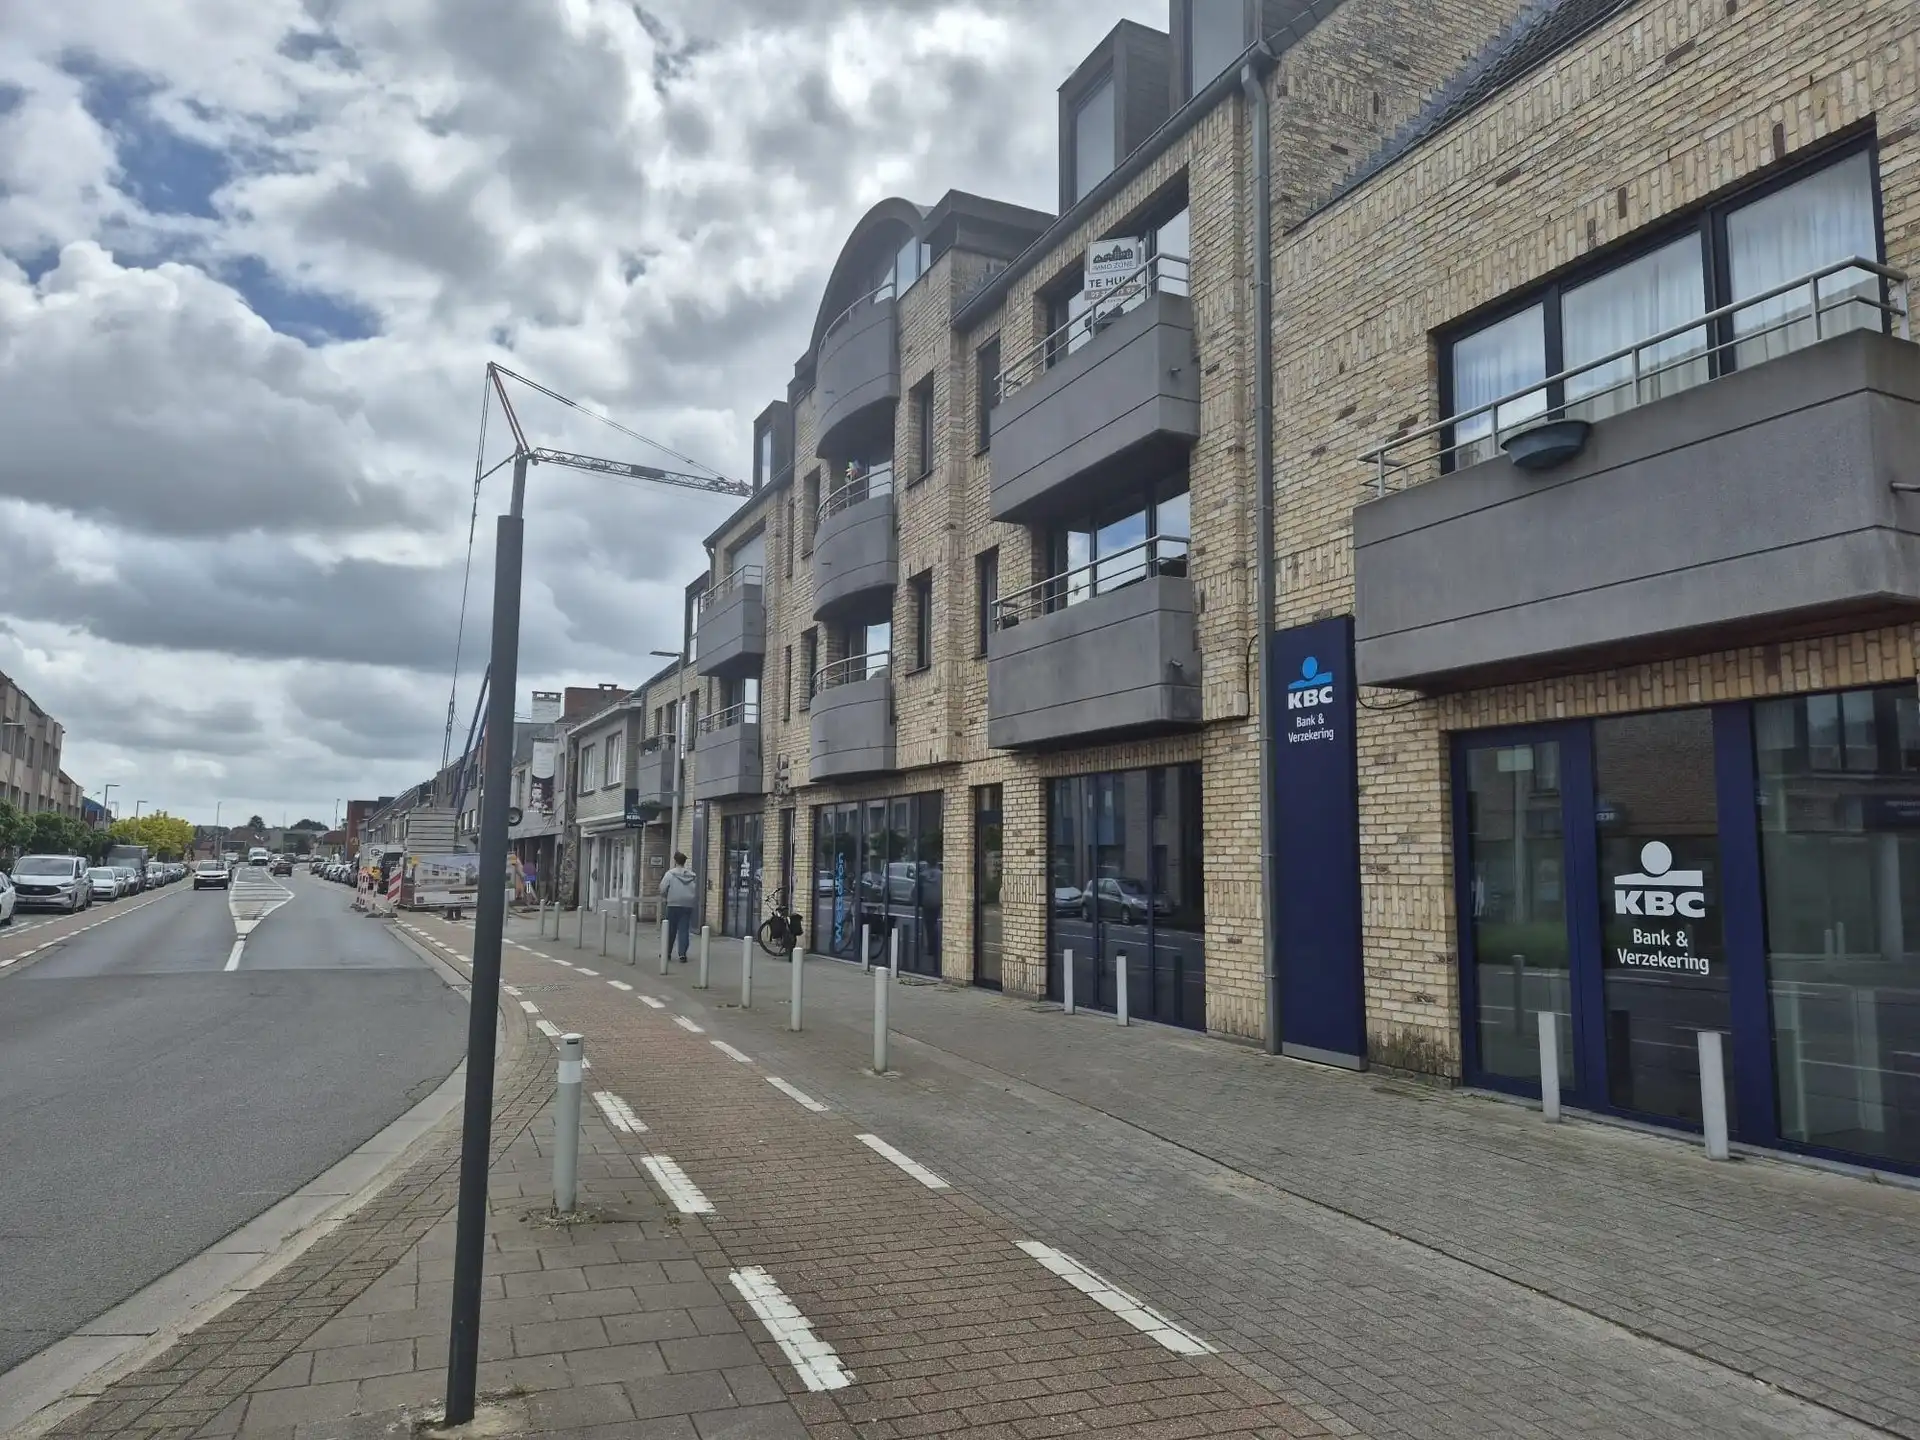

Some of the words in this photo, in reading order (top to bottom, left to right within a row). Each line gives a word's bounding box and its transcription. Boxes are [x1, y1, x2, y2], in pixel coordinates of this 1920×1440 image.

[1088, 278, 1102, 288] TE
[1105, 276, 1137, 286] HUR
[1287, 686, 1333, 710] KBC
[1296, 715, 1316, 728] Bank
[1318, 713, 1325, 725] &
[1288, 727, 1333, 743] Verzekering
[1614, 890, 1706, 918] KBC
[1633, 928, 1671, 946] Bank
[1676, 931, 1688, 947] &
[1617, 948, 1710, 975] Verzekering
